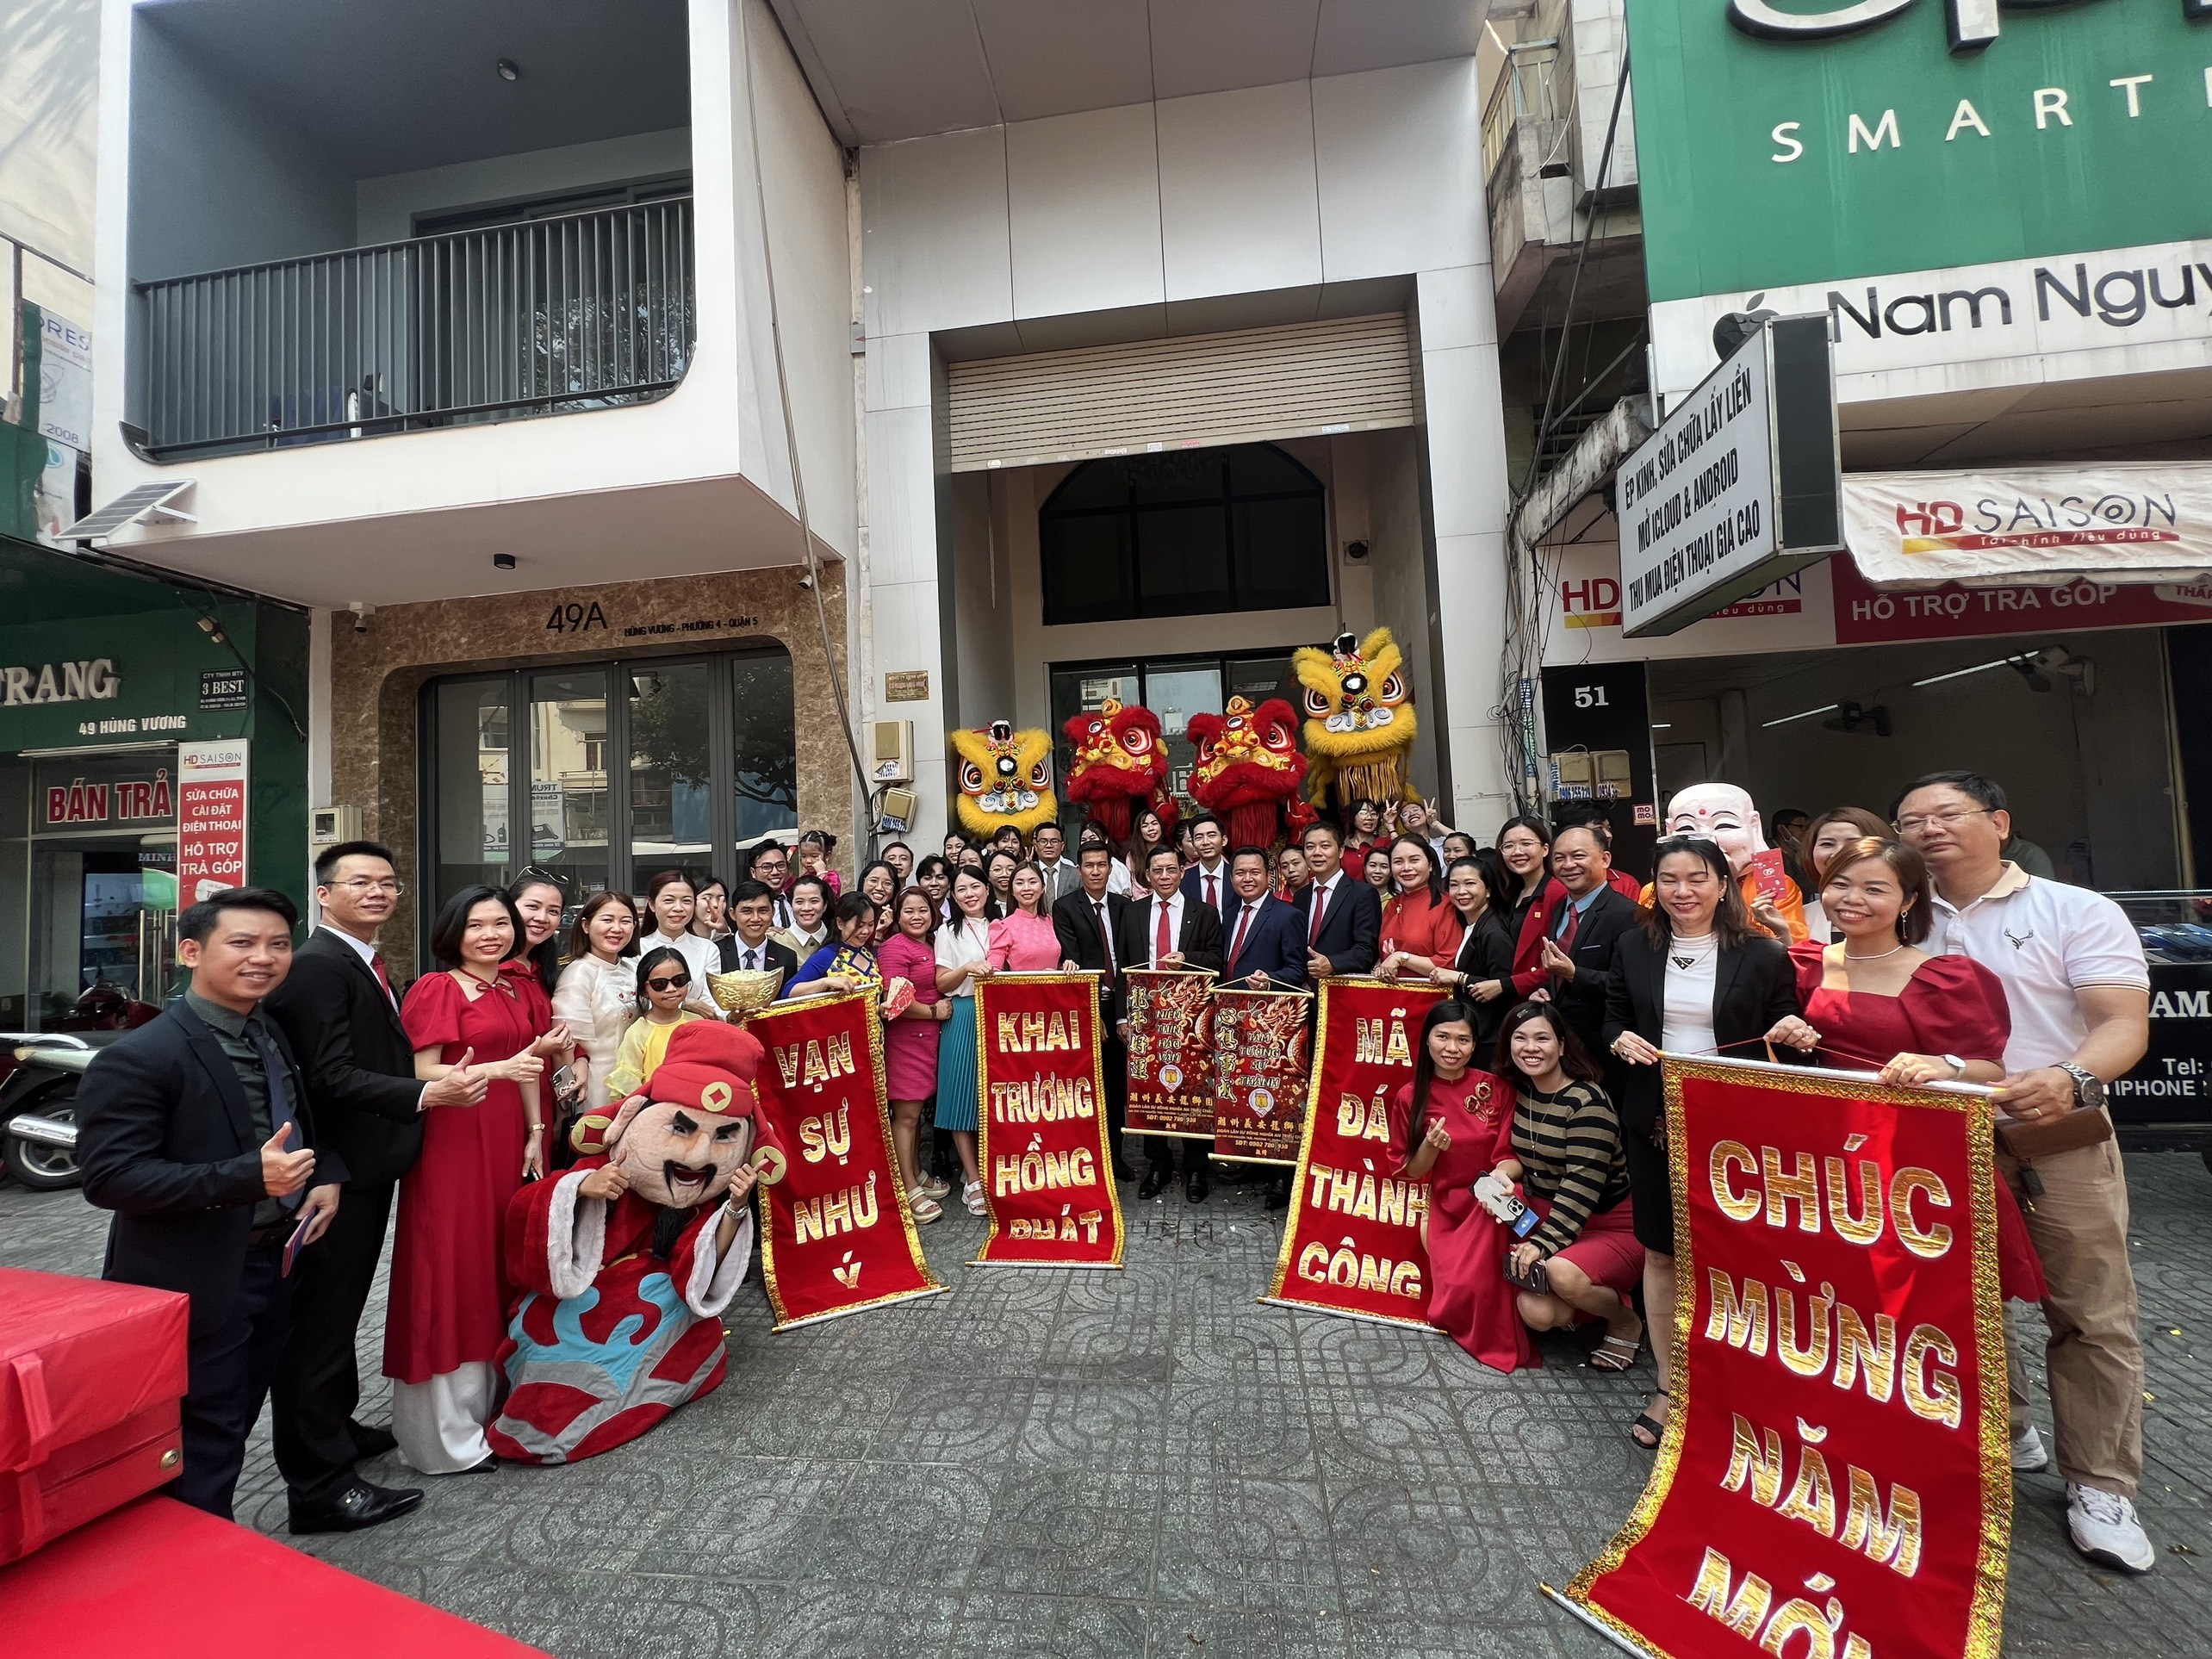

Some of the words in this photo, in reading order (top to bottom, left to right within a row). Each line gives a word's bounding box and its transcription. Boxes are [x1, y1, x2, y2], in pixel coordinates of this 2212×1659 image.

[1771, 67, 2212, 163] SMART
[1827, 287, 2013, 343] Nam
[1625, 475, 1635, 510] ÉP
[1636, 459, 1658, 501] KÍNH,
[1658, 432, 1676, 482] SỬA
[1678, 412, 1704, 464] CHỮA
[1705, 385, 1724, 442] LẤY
[1726, 363, 1752, 424] LIỀN
[1637, 507, 1651, 554] MỞ
[1651, 491, 1682, 544] ICLOUD
[1684, 485, 1691, 520] &
[1693, 446, 1739, 513] ANDROID
[1896, 500, 1964, 536] HD
[1973, 494, 2177, 533] SAISON
[2116, 529, 2160, 541] dùng
[1629, 576, 1643, 612] THU
[1644, 563, 1663, 604] MUA
[1663, 546, 1685, 593] ĐIỆN
[1685, 529, 1715, 575] THOẠI
[1716, 509, 1736, 557] GIÁ
[1737, 499, 1761, 548] CAO
[1562, 578, 1620, 612] HD
[1748, 603, 1785, 613] dùng
[1852, 593, 1895, 621] HỖ
[1904, 593, 1970, 619] TRỢ
[545, 601, 608, 633] 49A
[624, 626, 646, 637] HÙNG
[648, 623, 674, 635] VƯƠNG
[681, 619, 713, 632] PHƯỜNG
[716, 619, 721, 628] 4
[729, 615, 751, 629] QUẬN
[752, 617, 758, 625] 5
[202, 682, 209, 695] 3
[213, 679, 245, 694] BEST
[1575, 686, 1609, 708] 51
[78, 722, 96, 735] 49
[99, 717, 137, 734] HÙNG
[141, 715, 187, 730] VƯƠNG
[184, 755, 198, 765] HD
[200, 751, 242, 764] SAISON
[47, 777, 109, 823] BÁN
[115, 767, 173, 820] TRẢ
[186, 787, 207, 802] SỬA
[208, 786, 239, 800] CHỮA
[191, 804, 209, 817] CÀI
[211, 802, 233, 817] ĐẶT
[183, 819, 207, 835] ĐIỆN
[208, 819, 242, 833] THOẠI
[181, 860, 208, 875] TRẢ
[212, 858, 242, 874] GÓP
[183, 841, 204, 857] HỖ
[208, 842, 239, 858] TRỢ
[997, 1010, 1082, 1053] KHAI
[1247, 1030, 1272, 1043] TÂM
[1355, 1008, 1413, 1067] MÃ
[774, 1030, 855, 1093] VẠN
[2162, 1058, 2203, 1076] Tel:
[991, 1072, 1094, 1123] TRƯƠNG
[2115, 1079, 2196, 1097] IPHONE
[798, 1097, 851, 1165] SỰ
[995, 1132, 1097, 1197] HỒNG
[793, 1170, 879, 1245] NHƯ
[1309, 1159, 1430, 1227] THÀNH
[1710, 1133, 1953, 1259] CHÚC
[832, 1250, 861, 1289] Ý
[1298, 1235, 1422, 1300] CÔNG
[1705, 1259, 1963, 1429] MỪNG
[1720, 1412, 1923, 1578] NĂM
